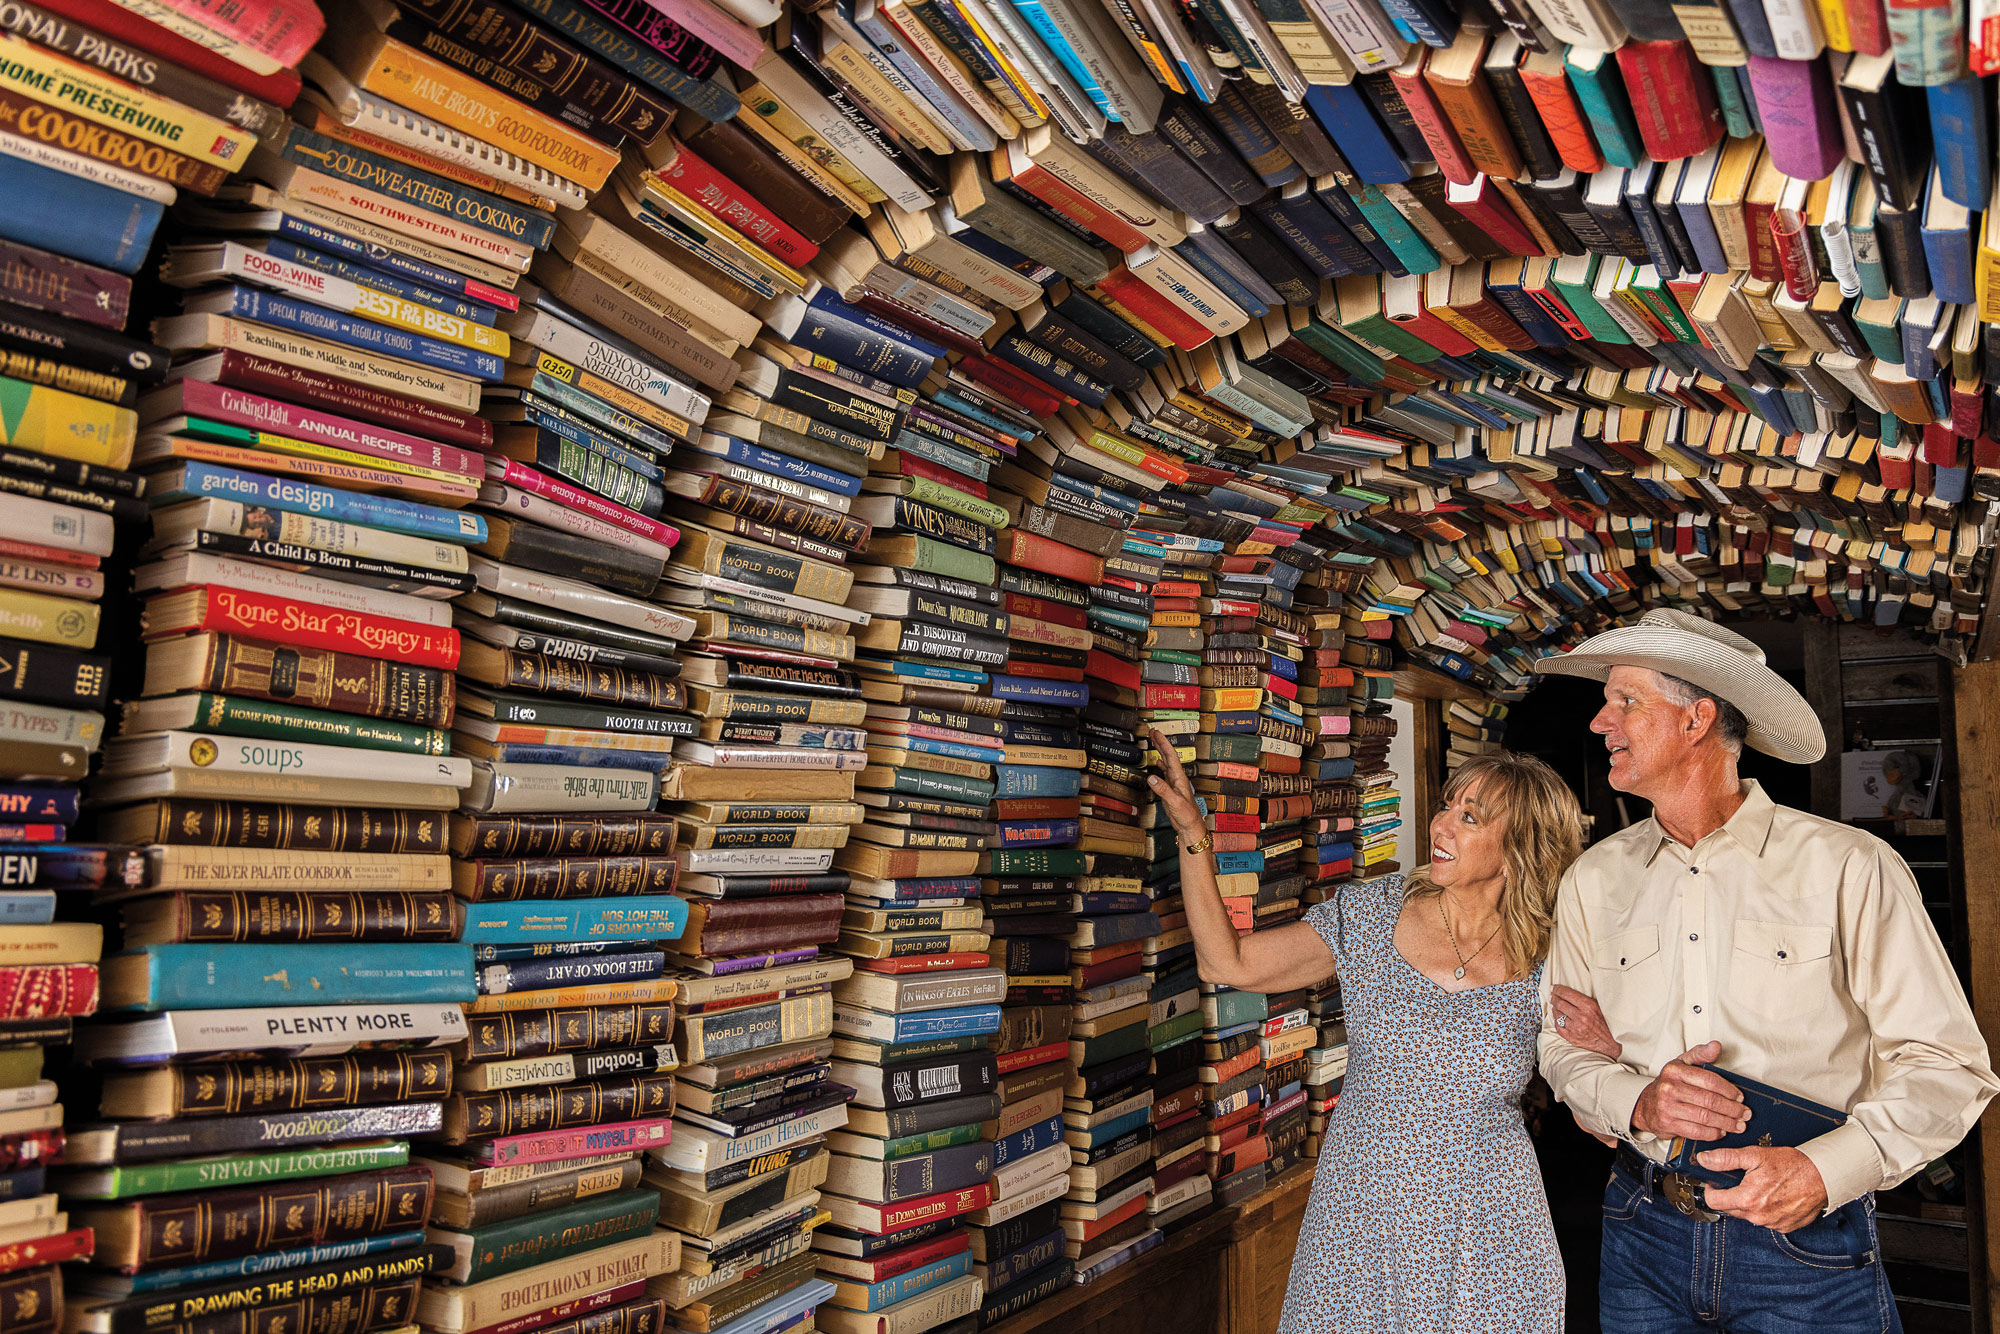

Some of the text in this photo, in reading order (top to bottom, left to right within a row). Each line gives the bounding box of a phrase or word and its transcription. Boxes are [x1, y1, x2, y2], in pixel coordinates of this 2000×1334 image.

[74, 33, 157, 84] PARKS
[920, 6, 991, 79] WORLD BOOK
[58, 83, 184, 142] PRESERVING
[412, 74, 592, 173] JANE BRODY'S GOOD FOOD BOOK
[18, 105, 189, 183] COOKBOOK
[35, 146, 79, 171] Moved
[82, 162, 101, 178] My
[105, 171, 156, 194] Cheese?
[323, 149, 527, 237] COLD-WEATHER COOKING
[350, 196, 511, 256] SOUTHWESTERN KITCHEN
[244, 254, 282, 275] FOOD
[289, 268, 325, 290] WINE
[903, 256, 966, 294] STUART WOODS
[268, 301, 297, 324] SPECIAL
[300, 309, 339, 332] PROGRAMS
[351, 322, 381, 343] REGULAR
[383, 329, 413, 351] SCHOOLS
[353, 286, 467, 341] BEST OF THE BEST
[592, 293, 618, 312] NEW
[681, 344, 717, 372] SURVEY
[243, 329, 287, 355] Teaching
[288, 342, 299, 356] in
[300, 344, 314, 359] the
[316, 348, 348, 368] Middle
[349, 359, 366, 371] and
[368, 362, 411, 386] Secondary
[542, 356, 572, 379] USED
[581, 340, 652, 393] SOUTHERN COOKING
[298, 418, 359, 444] ANNUAL
[361, 432, 412, 457] RECIPES
[432, 446, 441, 467] 2001
[289, 459, 404, 486] NATIVE TEXAS GARDENS
[202, 472, 334, 511] garden design
[1049, 488, 1125, 519] WILD BILL DONOVAN
[902, 498, 944, 536] VINE'S
[250, 539, 462, 588] A Child Is Born Lennart Nilsson Lars Hamberger
[725, 556, 796, 579] WORLD BOOK
[218, 592, 431, 655] Lone Star Legacy II
[923, 625, 967, 643] DISCOVERY
[542, 638, 599, 663] CHRIST
[901, 639, 1004, 665] AND CONQUEST OF MEXICO
[230, 708, 402, 744] HOME FOR THE HOLIDAYS Ken Haedrich
[605, 715, 643, 730] BLOOM
[661, 719, 692, 734] TEXAS
[732, 702, 806, 716] WORLD BOOK
[240, 744, 304, 773] soups
[732, 807, 806, 819] WORLD BOOK
[183, 864, 352, 881] THE SILVER PALATE COOKBOOK
[769, 878, 809, 892] HITLER
[546, 958, 655, 981] THE BOOK OF ART
[267, 1013, 413, 1035] PLENTY MORE
[706, 1018, 778, 1041] WORLD BOOK
[505, 1051, 644, 1082] Football DUMMIES
[259, 1114, 348, 1142] COOKBOOK
[726, 1117, 819, 1161] HEALTHY HEALING
[199, 1161, 259, 1182] PARIS
[284, 1148, 379, 1172] BAREFOOT
[748, 1150, 792, 1178] LIVING
[183, 1257, 425, 1318] DRAWING THE HEAD AND HANDS
[500, 1253, 649, 1312] JEWISH KNOWLEDGE
[686, 1265, 735, 1296] HOMES
